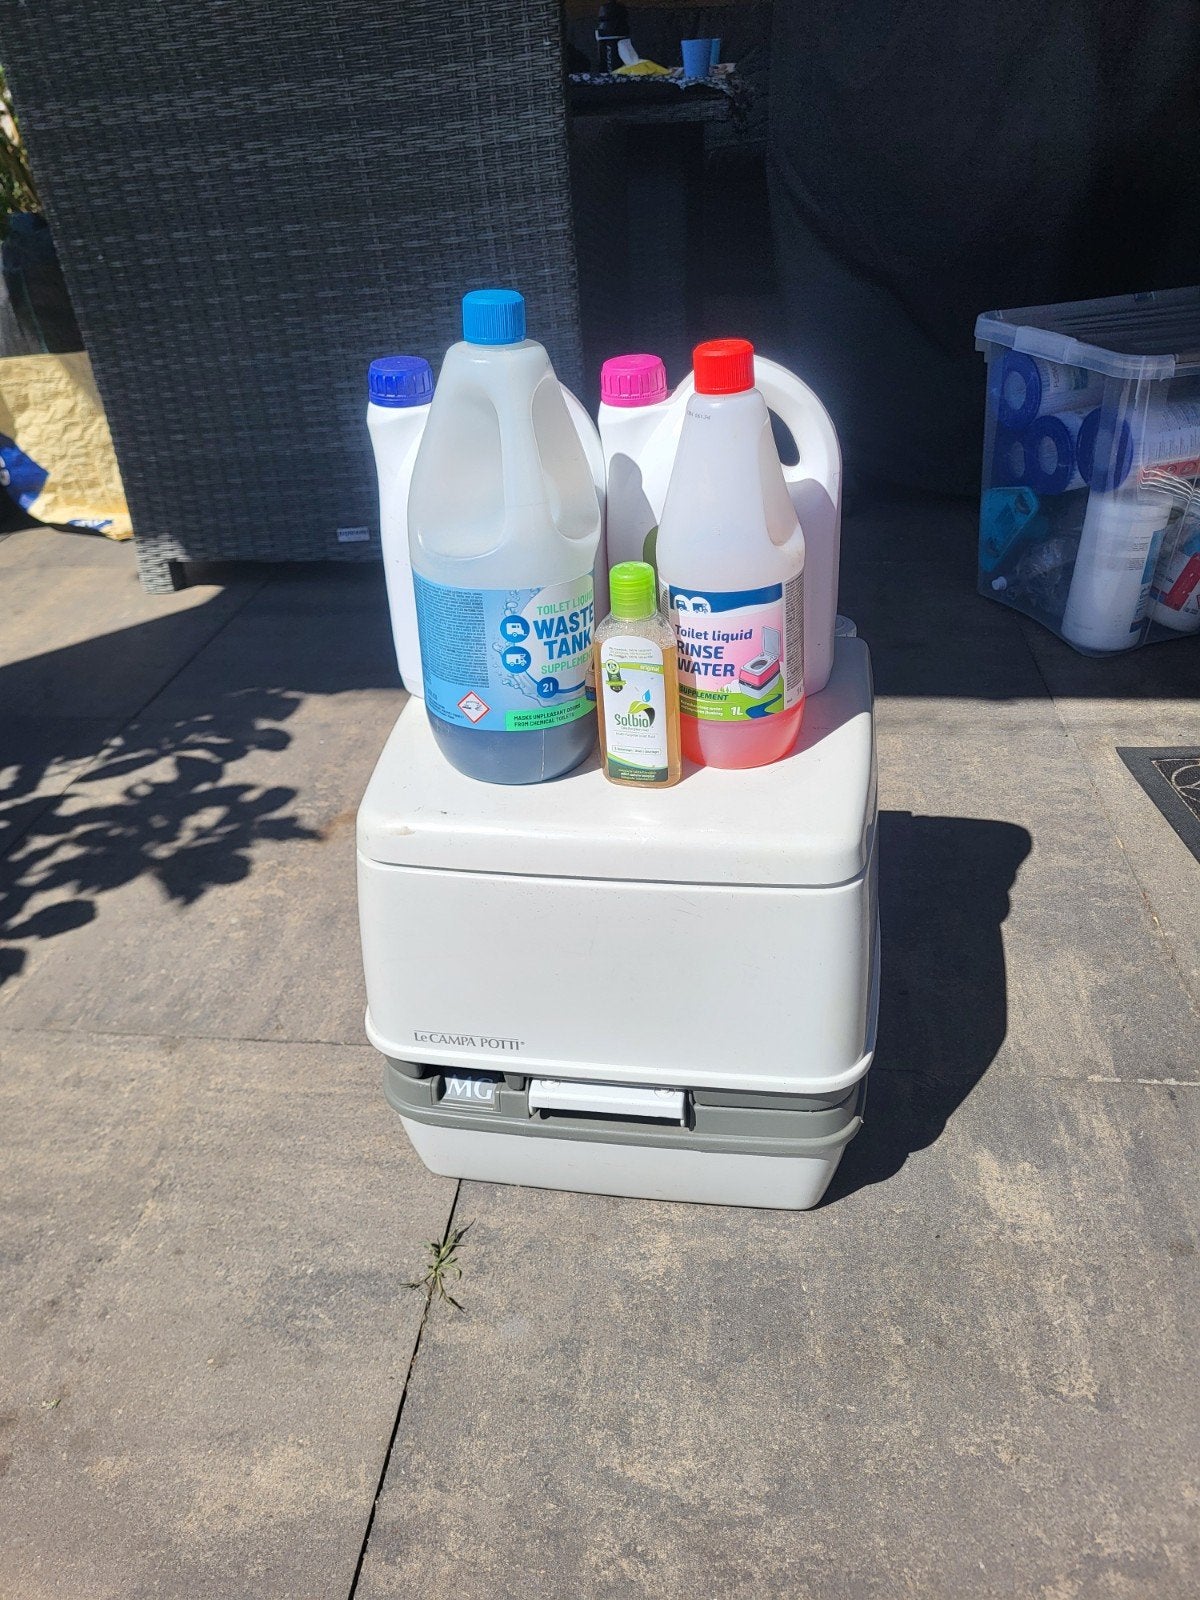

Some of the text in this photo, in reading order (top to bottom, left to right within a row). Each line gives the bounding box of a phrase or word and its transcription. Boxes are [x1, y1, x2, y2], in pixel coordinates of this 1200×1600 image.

[537, 601, 570, 615] TOILET
[533, 602, 594, 640] WASTE
[675, 624, 753, 643] Toilet liquid
[543, 627, 592, 660] TANK
[676, 640, 725, 659] RINSE
[677, 656, 736, 677] WATER
[680, 684, 729, 701] SUPPLEMENT
[533, 709, 566, 720] UNPLEASANT
[614, 712, 649, 728] Solbio
[730, 706, 744, 716] 1L
[529, 717, 556, 727] CHEMICAL
[447, 1073, 494, 1100] MG
